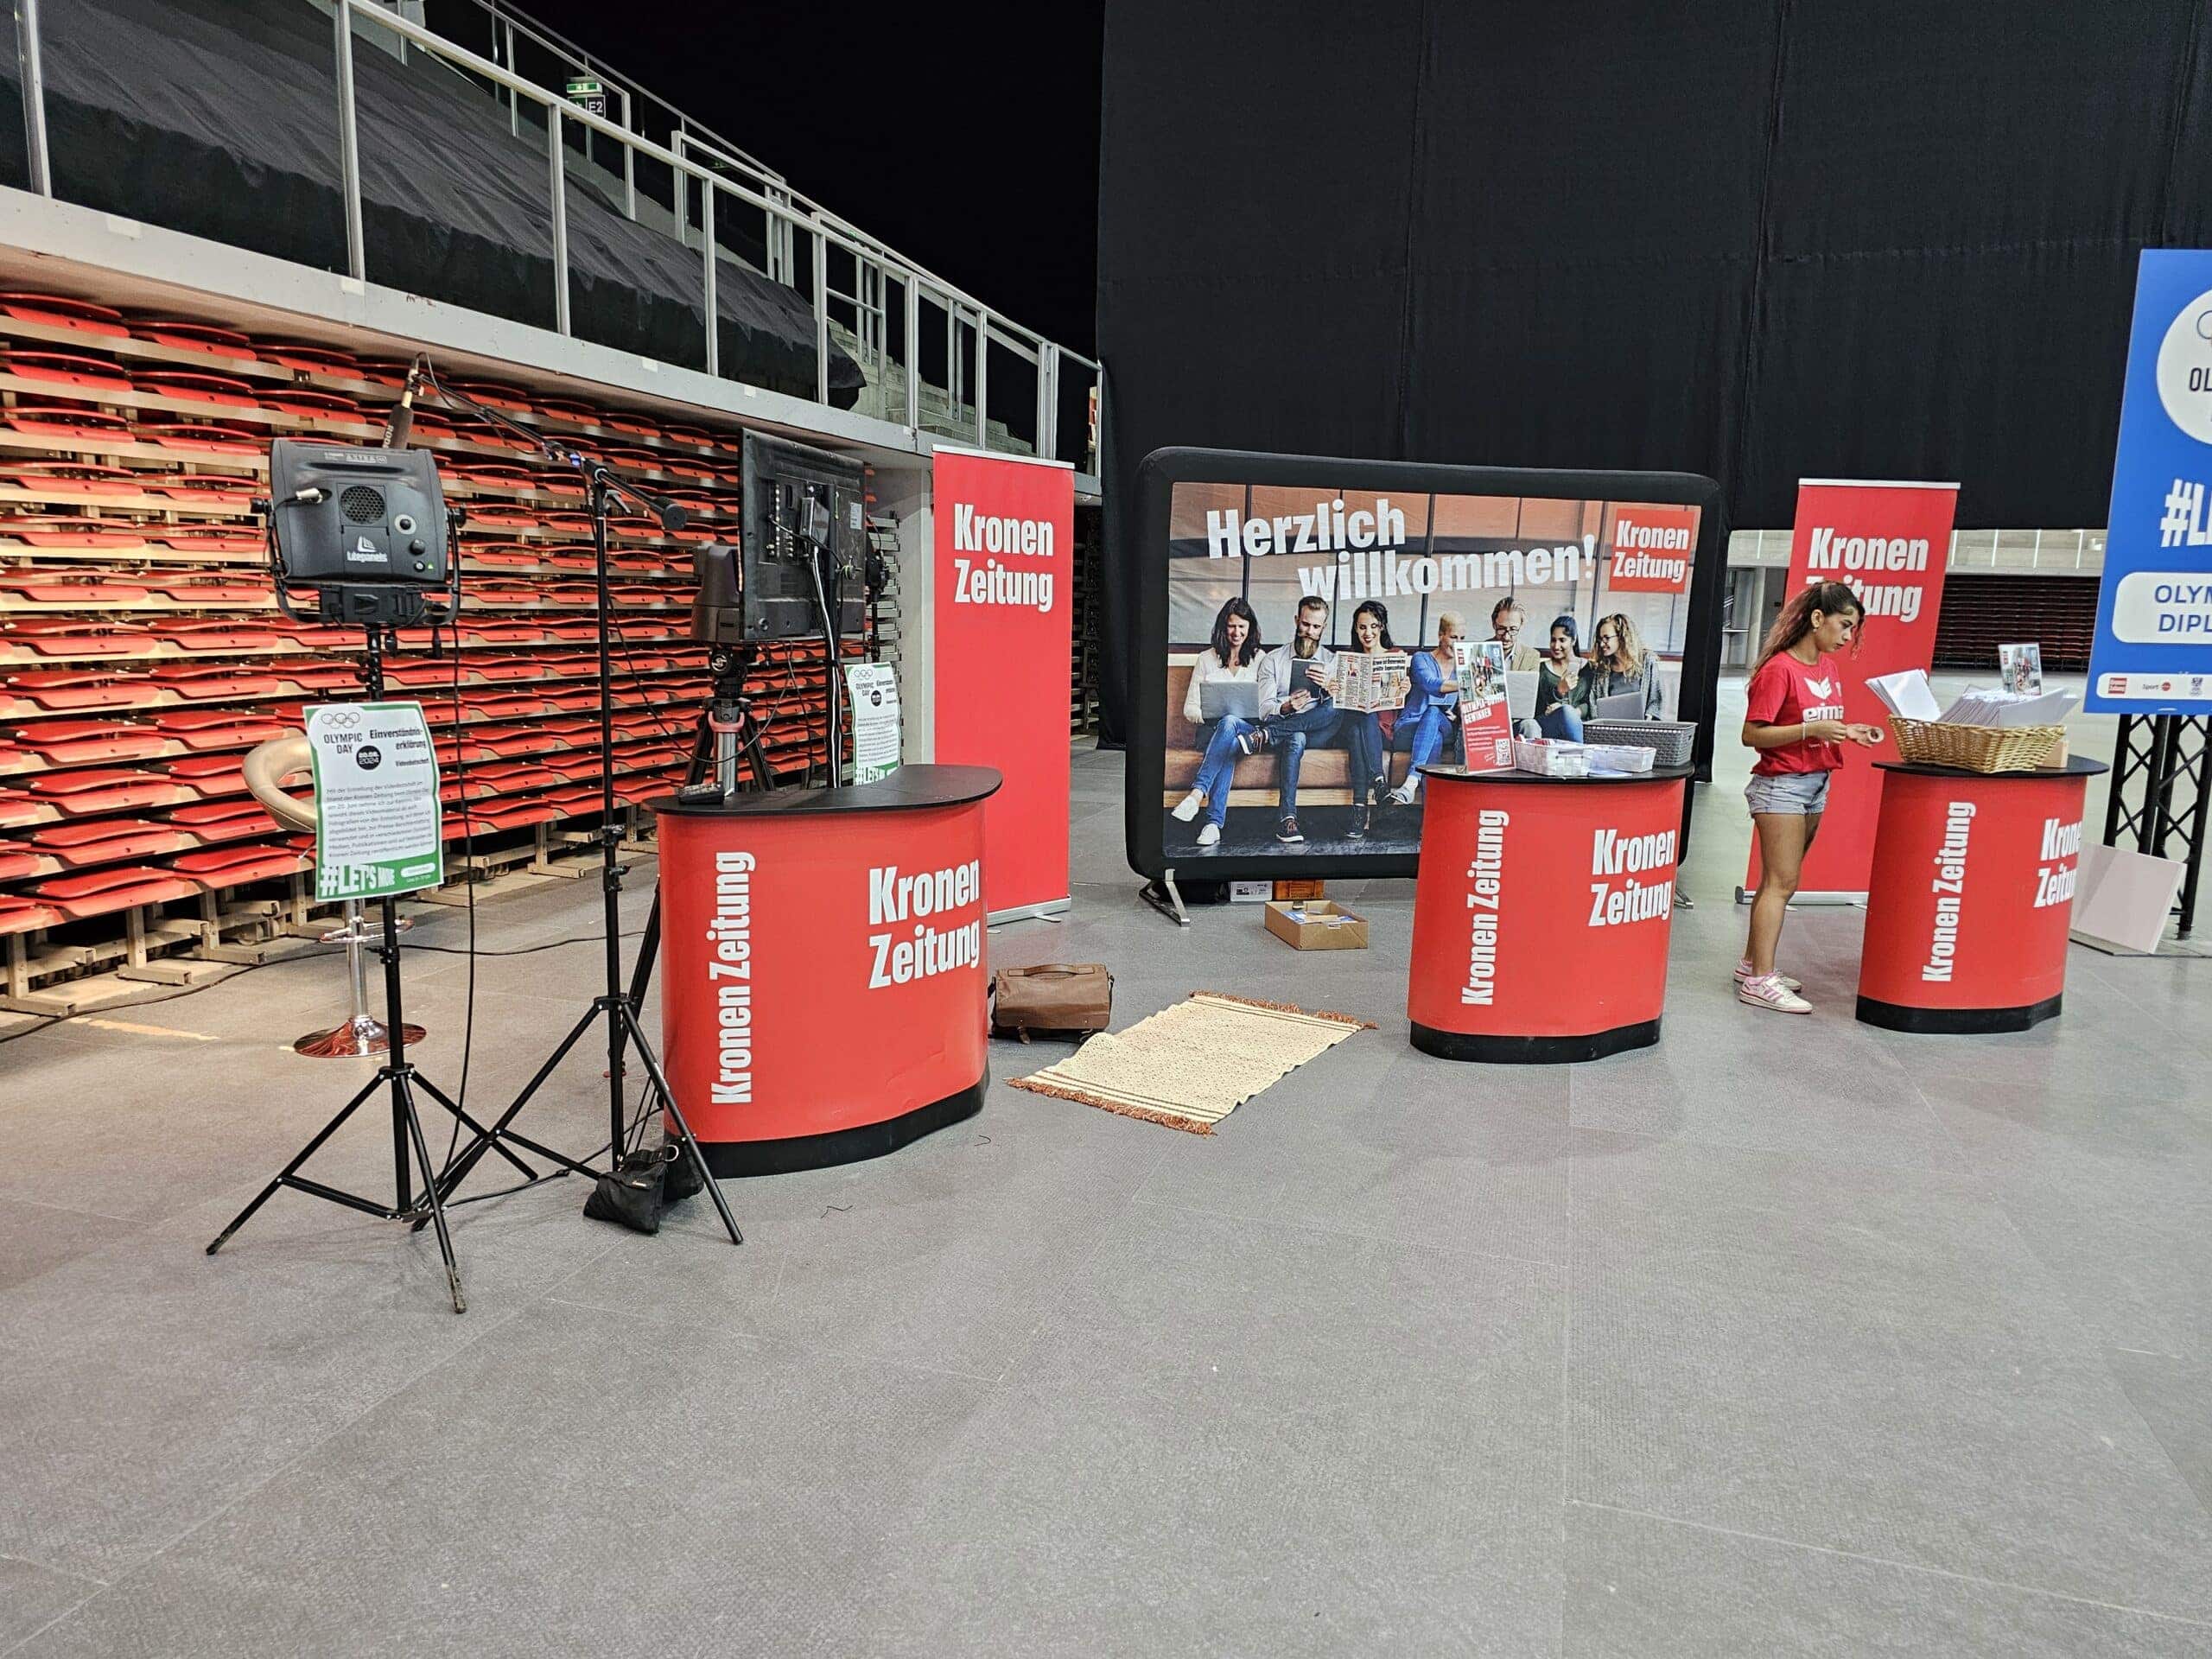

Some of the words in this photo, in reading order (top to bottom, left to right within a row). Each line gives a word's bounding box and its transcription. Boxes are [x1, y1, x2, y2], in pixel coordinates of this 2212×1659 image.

[588, 101, 603, 112] E2
[2189, 367, 2212, 391] OL
[954, 503, 1053, 556] Kronen
[1206, 499, 1406, 559] Herzlich
[1617, 520, 1689, 550] Kronen
[2160, 478, 2212, 548] #L
[1299, 534, 1596, 602] willkommen!
[1612, 551, 1686, 583] Zeitung
[1808, 528, 1929, 571] Kronen
[954, 559, 1053, 613] Zeitung
[1806, 575, 1923, 622] tung
[2158, 613, 2212, 632] DIPL
[324, 733, 363, 743] OLYMPIC
[337, 744, 353, 753] DAY
[1467, 810, 1510, 909] Zeitung
[1592, 829, 1675, 875] Kronen
[1932, 802, 1976, 893] Zeitung
[706, 851, 756, 981] Zeitung
[868, 859, 979, 925] Kronen
[1588, 879, 1672, 927] Zeitung
[868, 919, 980, 988] Zeitung
[1461, 914, 1499, 1005] Kronen
[1922, 897, 1961, 982] Kronen
[711, 986, 752, 1104] Kronen
